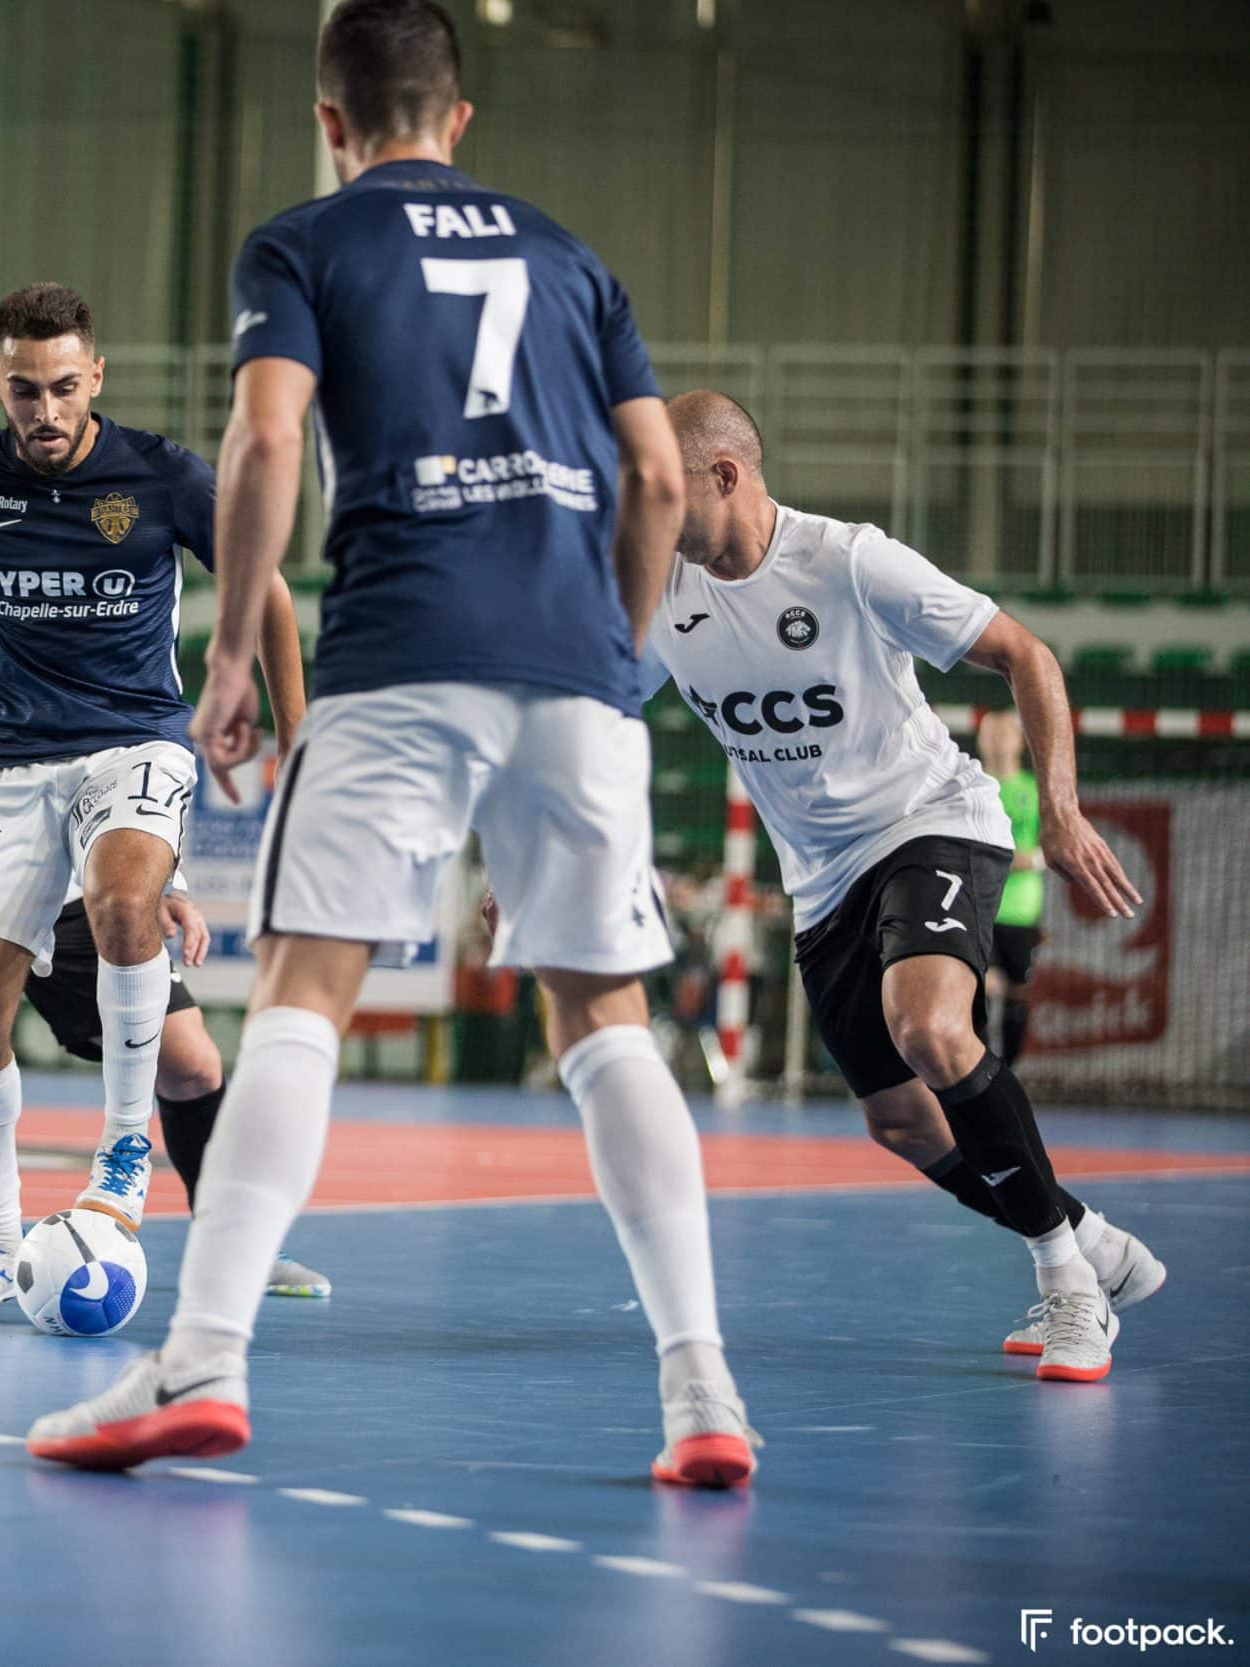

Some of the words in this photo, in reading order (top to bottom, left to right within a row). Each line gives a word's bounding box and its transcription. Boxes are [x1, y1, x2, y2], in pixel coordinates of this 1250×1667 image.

[403, 203, 517, 238] FALI
[420, 257, 531, 419] 7
[773, 744, 823, 762] CLUB
[128, 761, 185, 808] 17
[935, 869, 963, 911] 7
